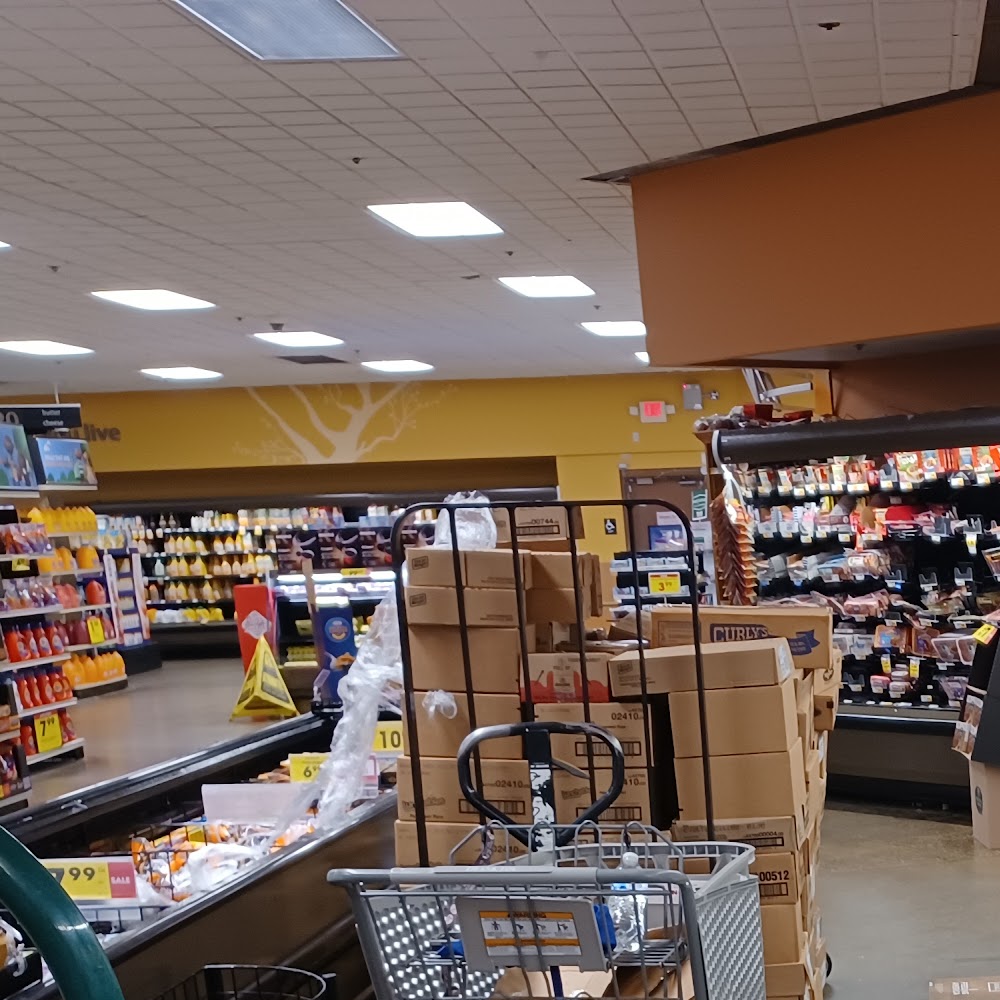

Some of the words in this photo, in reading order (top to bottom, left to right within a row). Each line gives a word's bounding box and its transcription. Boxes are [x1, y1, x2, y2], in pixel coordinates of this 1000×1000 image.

[713, 626, 768, 642] CURLY'S
[611, 712, 639, 720] 02410
[495, 780, 523, 788] 02410
[759, 870, 790, 882] 00512
